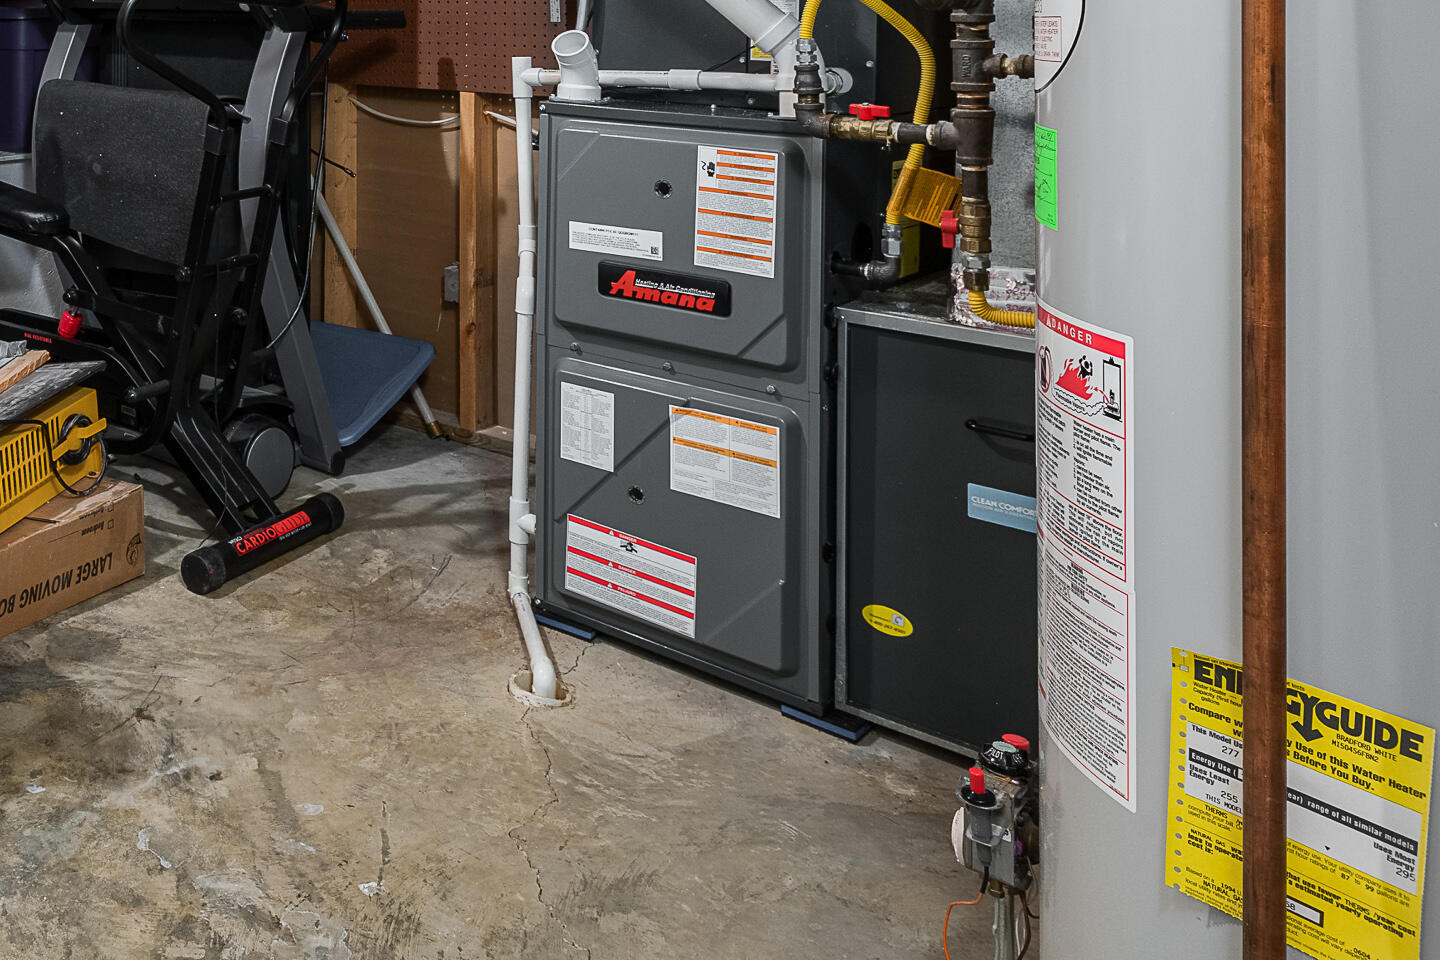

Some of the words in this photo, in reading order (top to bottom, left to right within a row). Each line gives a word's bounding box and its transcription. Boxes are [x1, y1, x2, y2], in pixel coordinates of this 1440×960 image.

[609, 270, 716, 311] Amana
[675, 284, 716, 299] Conditioning
[1051, 318, 1093, 345] DANGER
[970, 495, 998, 508] CLEAN
[998, 502, 1037, 516] COMFOR
[75, 552, 113, 584] LARGE
[19, 569, 73, 609] MOVING
[1188, 702, 1231, 725] Compare
[1193, 658, 1424, 762] ENGYGUIDE
[1192, 725, 1206, 736] This
[1208, 731, 1231, 745] Model
[1222, 745, 1239, 759] 277
[1336, 733, 1371, 752] BRADFORD
[1374, 748, 1397, 762] WHITE
[1191, 752, 1215, 769] Energy
[1218, 762, 1231, 774] Use
[1293, 751, 1327, 771] Before
[1330, 765, 1349, 780] You
[1352, 773, 1375, 792] Buy.
[1295, 742, 1314, 756] Use
[1317, 750, 1327, 761] of
[1330, 754, 1348, 770] this
[1351, 763, 1386, 785] Water
[1388, 778, 1426, 800] Heater
[1189, 764, 1207, 776] Uses
[1209, 772, 1230, 786] Least
[1189, 770, 1215, 786] Energy
[1206, 793, 1220, 805] THIS
[1221, 790, 1238, 804] 255
[1205, 804, 1228, 819] THERMS
[1307, 800, 1329, 816] range
[1332, 810, 1339, 819] of
[1342, 814, 1351, 824] all
[1354, 819, 1383, 838] similar
[1385, 833, 1415, 851] models
[1373, 842, 1391, 855] Uses
[1394, 850, 1415, 865] Most
[1386, 855, 1415, 873] Energy
[1396, 867, 1416, 882] 295
